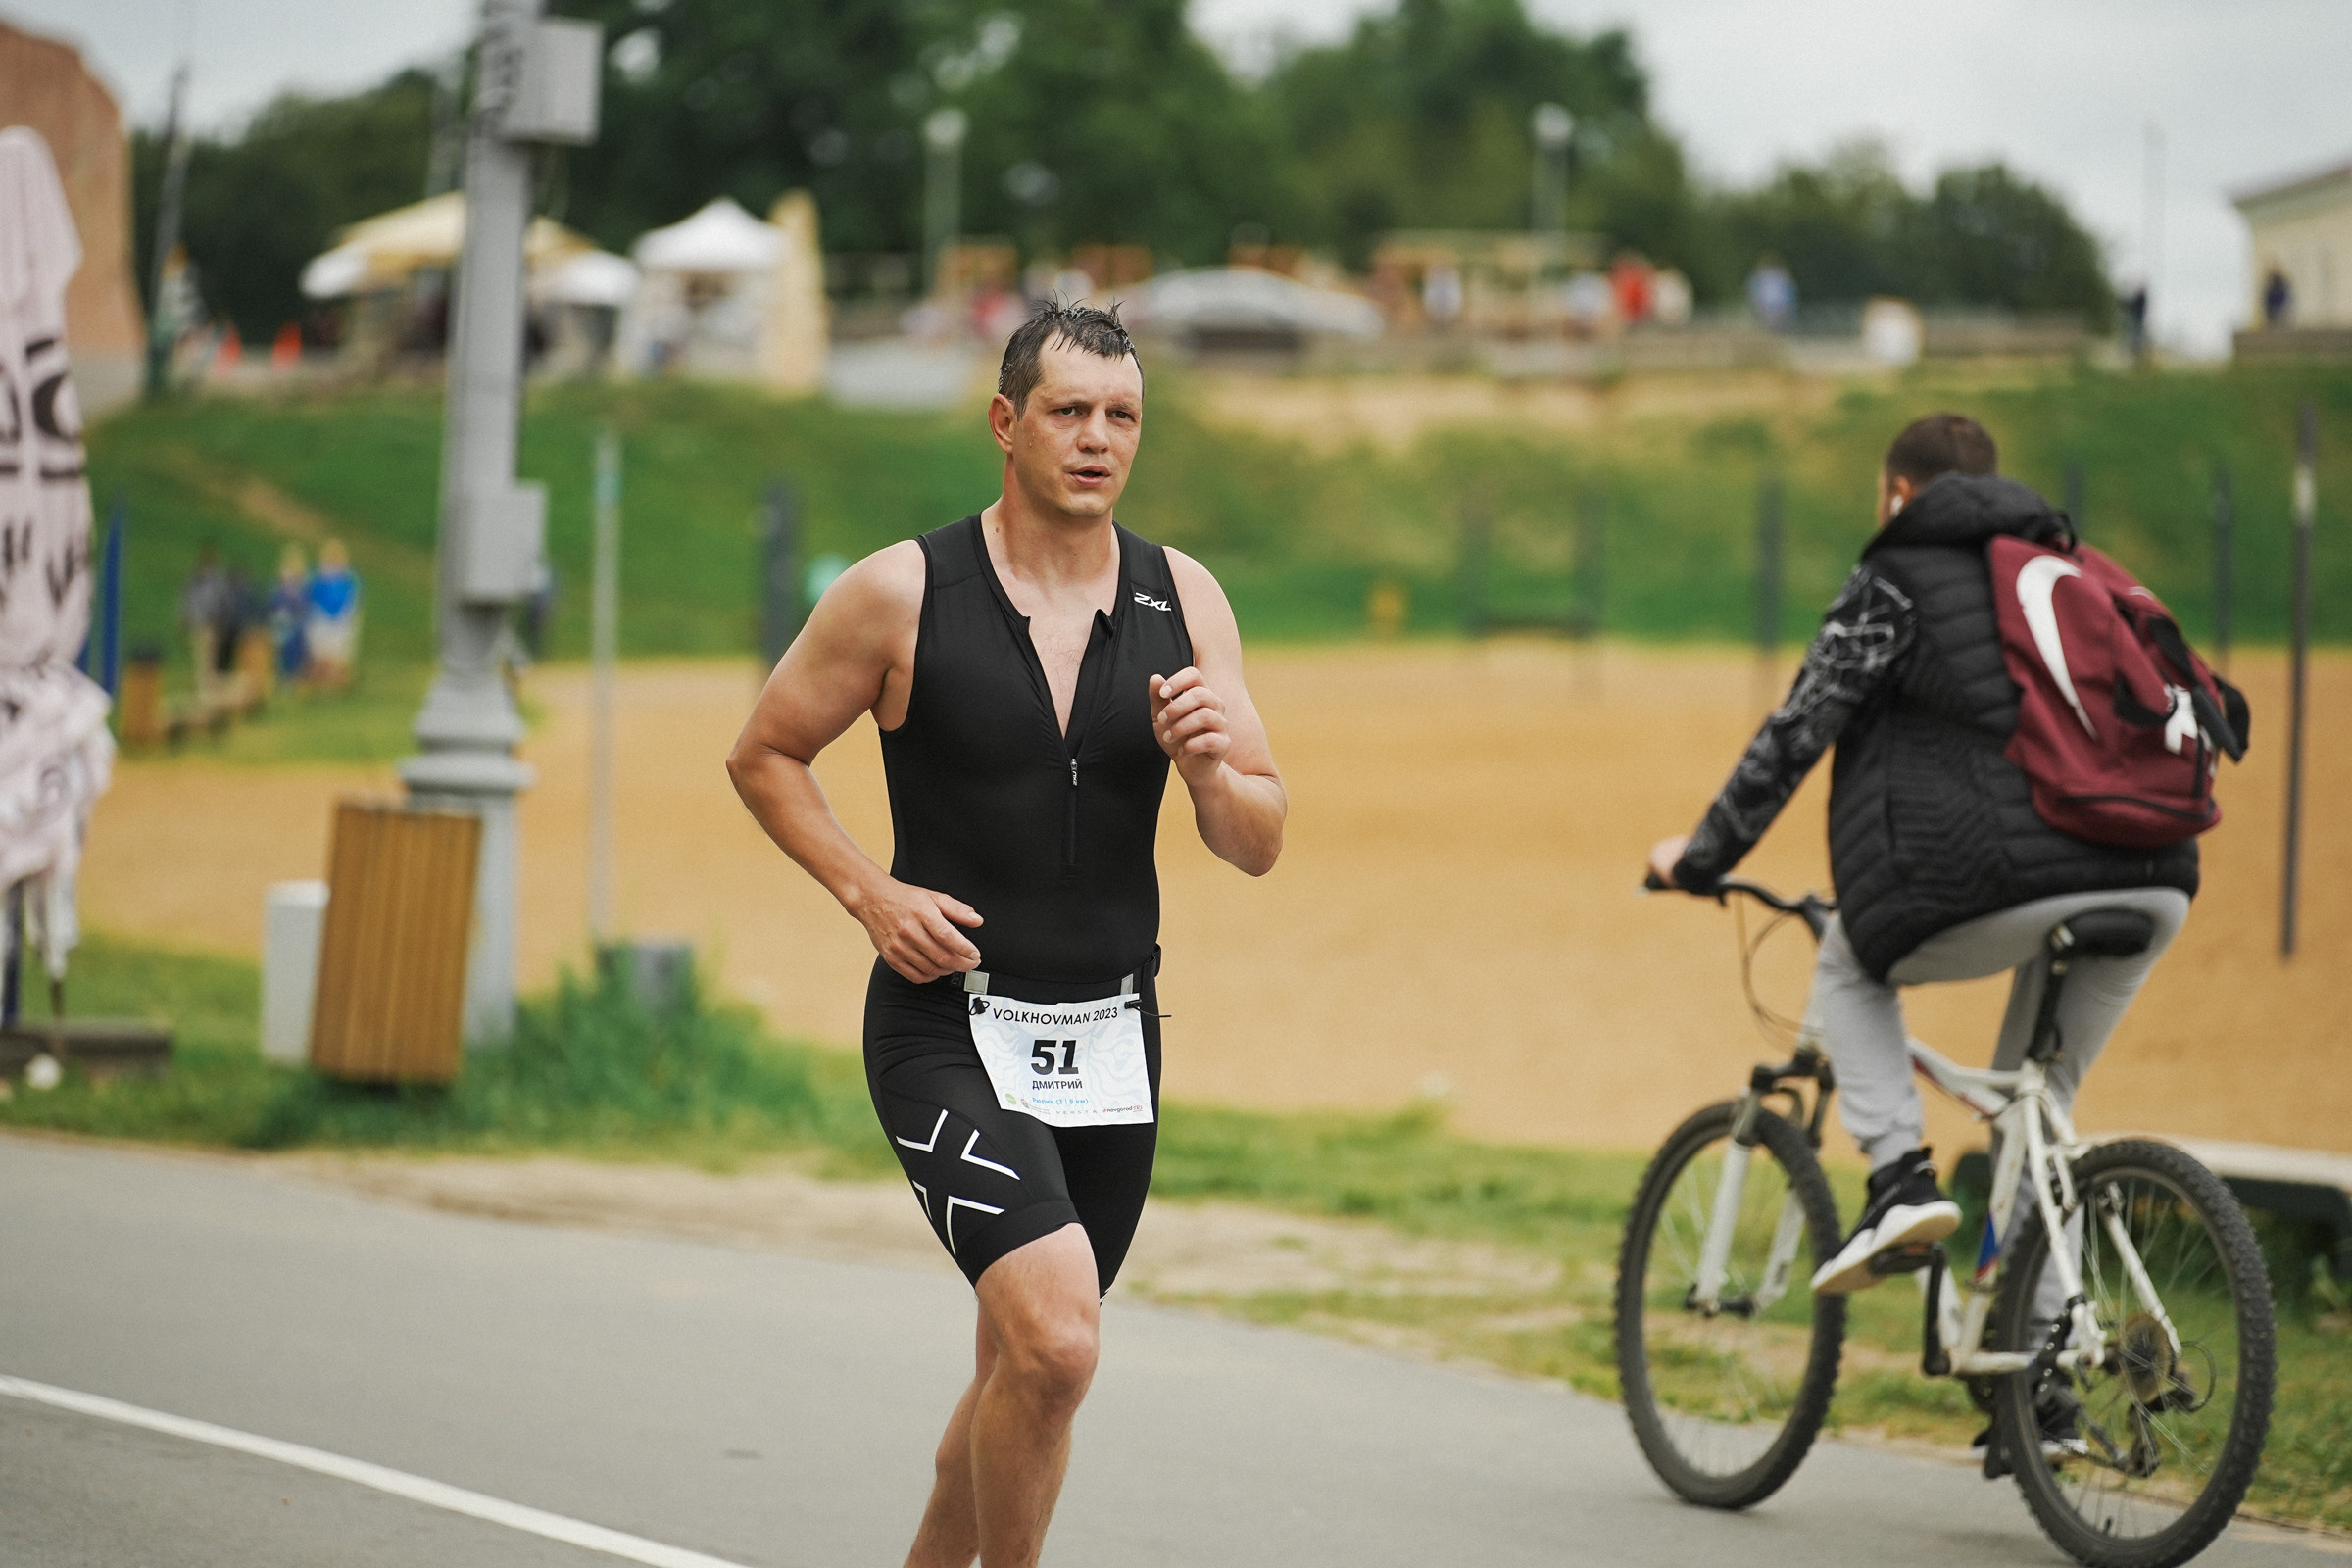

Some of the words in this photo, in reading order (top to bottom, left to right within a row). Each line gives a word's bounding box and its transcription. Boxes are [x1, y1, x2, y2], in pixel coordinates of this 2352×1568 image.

[993, 1007, 1091, 1025] VOLKHOVMAN
[1093, 1006, 1118, 1022] 2023
[1031, 1039, 1080, 1076] 51
[1032, 1078, 1083, 1091] ДМИТРИЙ
